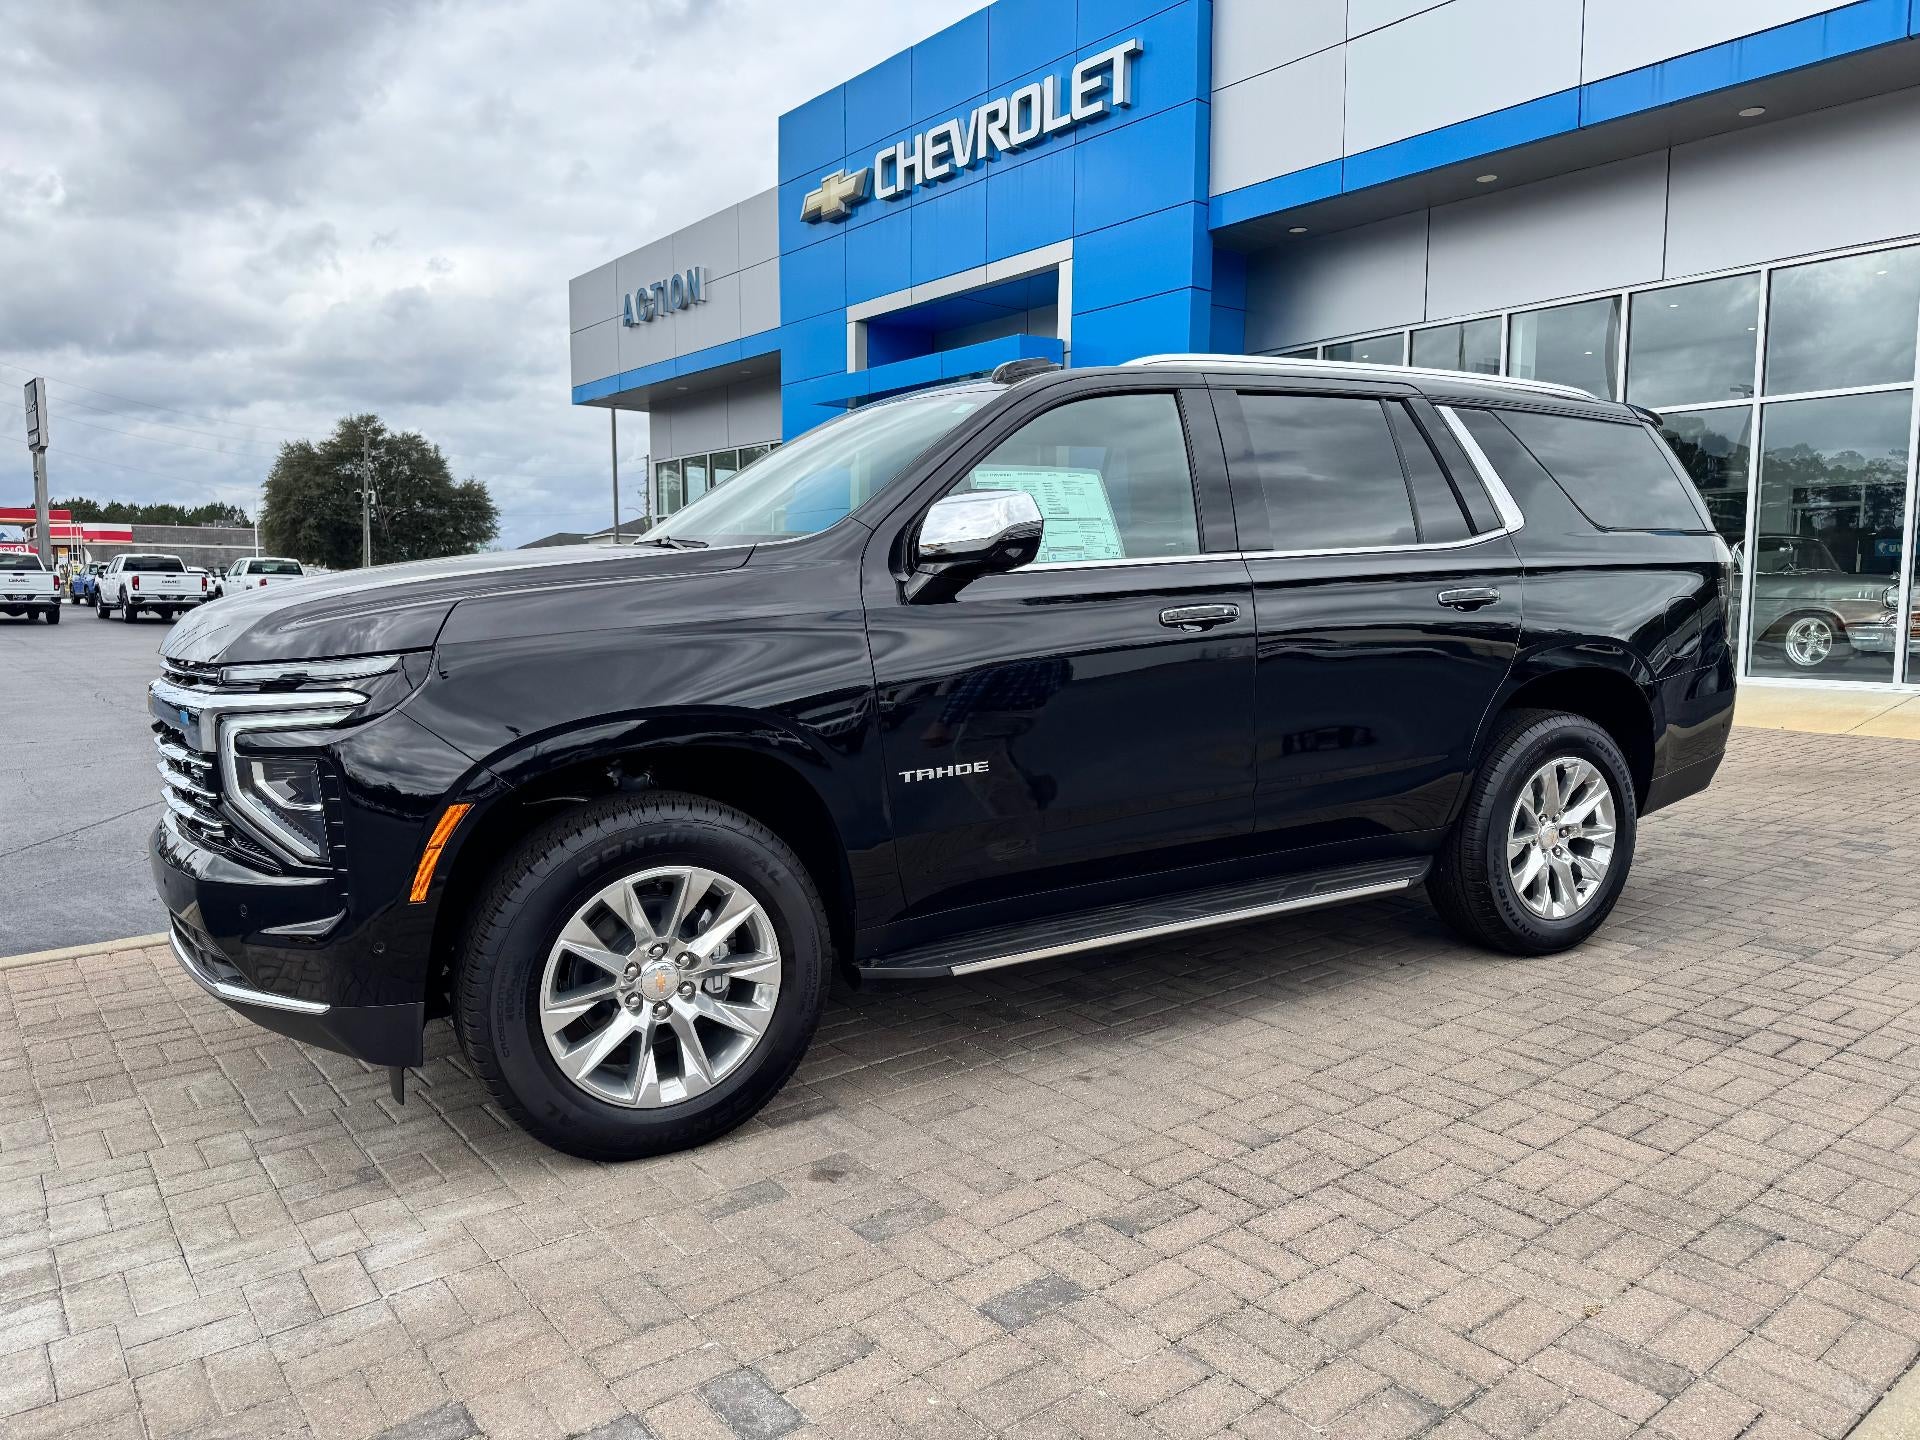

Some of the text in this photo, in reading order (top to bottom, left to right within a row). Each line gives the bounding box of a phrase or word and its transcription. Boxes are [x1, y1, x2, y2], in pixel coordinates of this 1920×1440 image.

[874, 37, 1141, 201] CHEVROLET
[623, 266, 703, 327] ACTION
[899, 760, 990, 783] TAHOE
[576, 830, 784, 888] CONTINTAL
